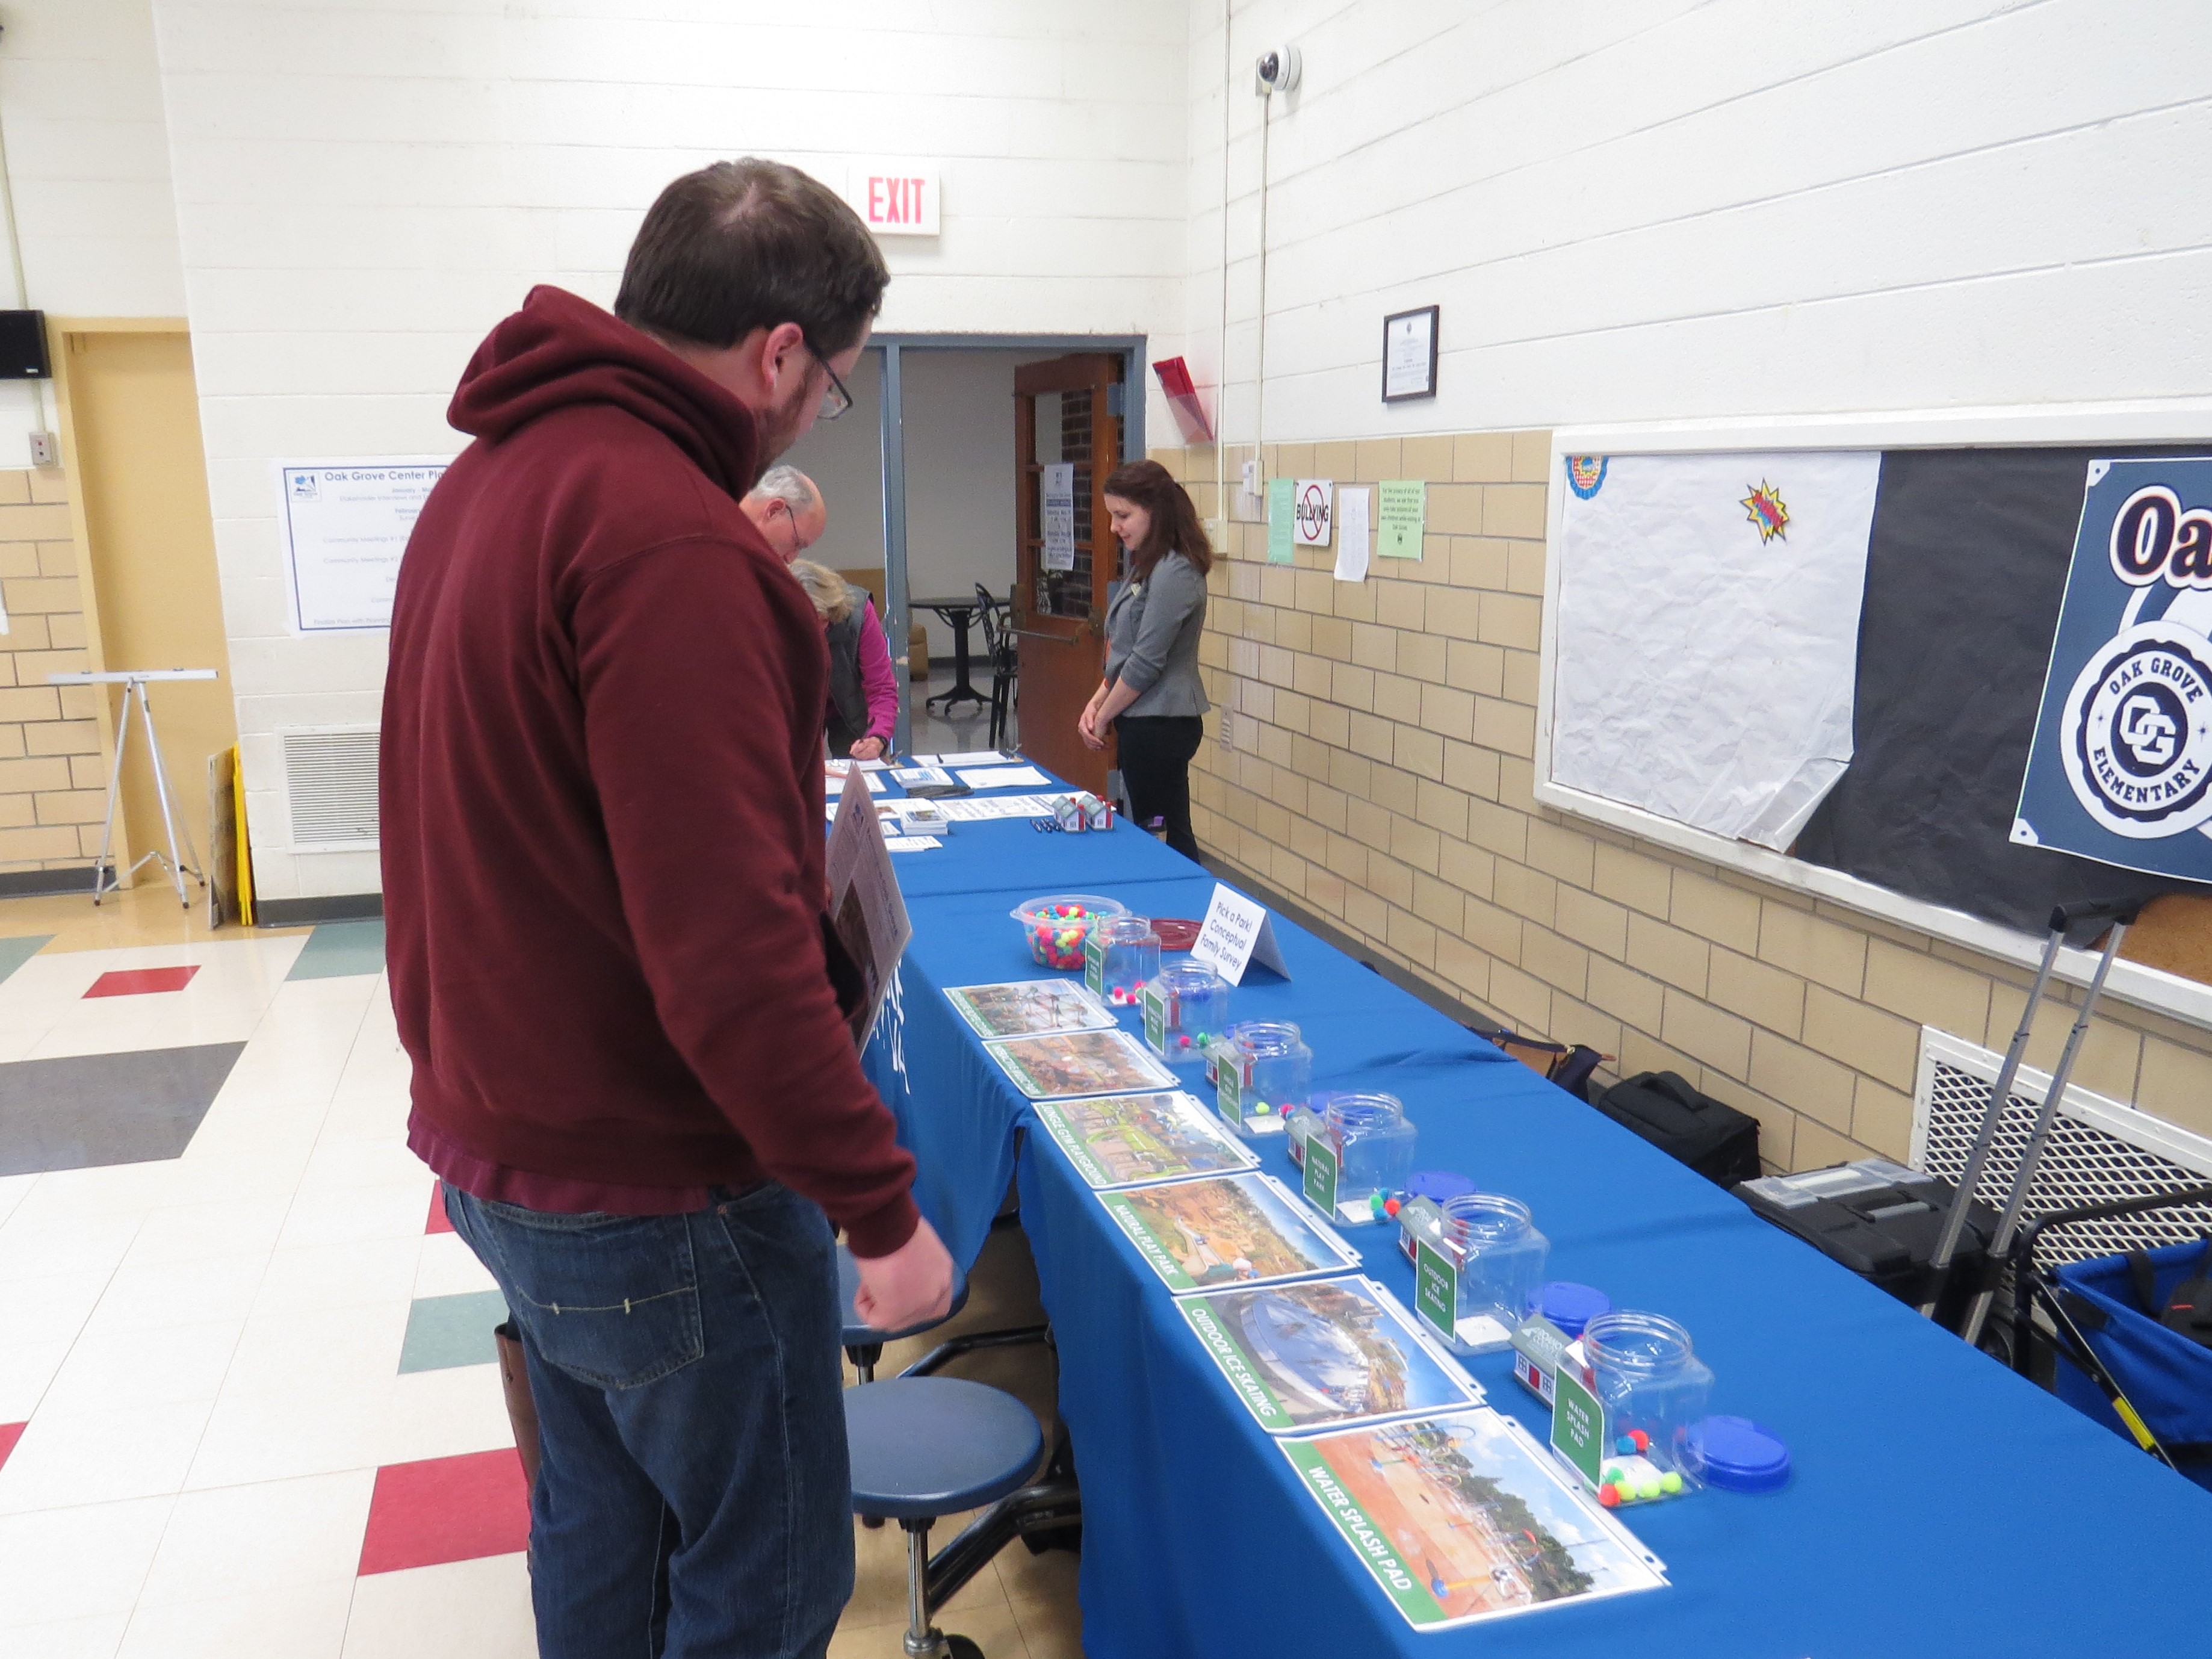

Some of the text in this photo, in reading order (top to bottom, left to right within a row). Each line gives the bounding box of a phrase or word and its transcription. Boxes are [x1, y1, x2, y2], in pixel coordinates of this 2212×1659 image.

[869, 177, 925, 225] EXIT
[325, 470, 444, 481] Oak Grove Center Pla
[1296, 504, 1329, 522] BULLYING
[2111, 488, 2212, 588] Oa
[2109, 657, 2204, 704] OAK GROVE
[2093, 746, 2201, 803] ELEMENTARY
[1216, 901, 1229, 918] Pick
[1235, 913, 1253, 933] Park!
[1210, 919, 1247, 950] Conceptual
[1200, 934, 1242, 972] Family Survey
[1041, 1105, 1107, 1185] JUNGLE GYM PLAYGROUND
[1315, 1168, 1324, 1181] PLAY
[1113, 1204, 1180, 1276] NATURAL PLAY PARK
[1424, 1263, 1449, 1291] OUTDOOR
[1425, 1287, 1446, 1312] SKATING
[1192, 1308, 1277, 1417] OUTDOOR ICE SKATING
[1567, 1410, 1589, 1440] SPLASH
[1568, 1397, 1589, 1425] WATER
[1570, 1428, 1584, 1448] PAD
[1308, 1466, 1413, 1591] WATER SPLASH PAD
